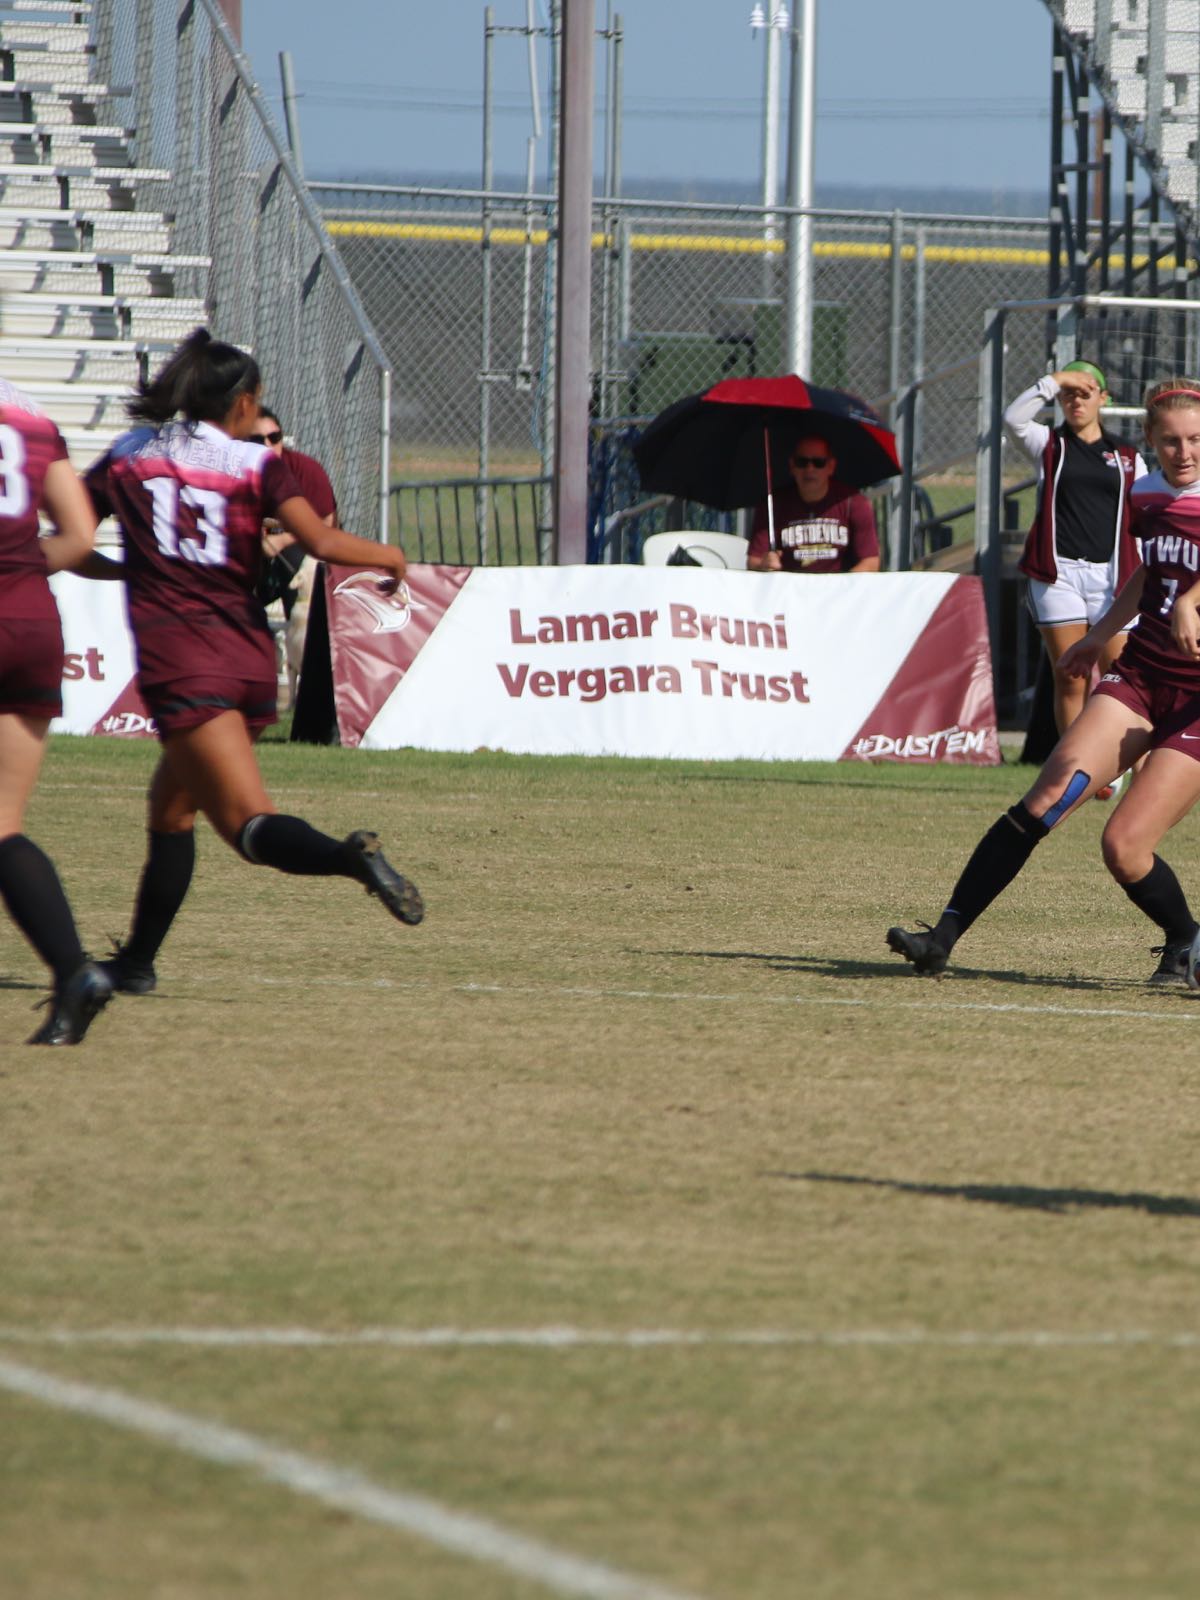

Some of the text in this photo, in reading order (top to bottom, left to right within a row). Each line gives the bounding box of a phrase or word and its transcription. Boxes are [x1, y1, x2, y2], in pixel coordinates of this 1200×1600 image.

[142, 476, 228, 567] 13
[1144, 535, 1199, 572] TWU
[1161, 579, 1178, 614] 7
[509, 603, 788, 649] Lamar Bruni
[62, 648, 105, 681] st
[496, 659, 810, 703] Vergara Trust
[102, 712, 159, 734] #DU
